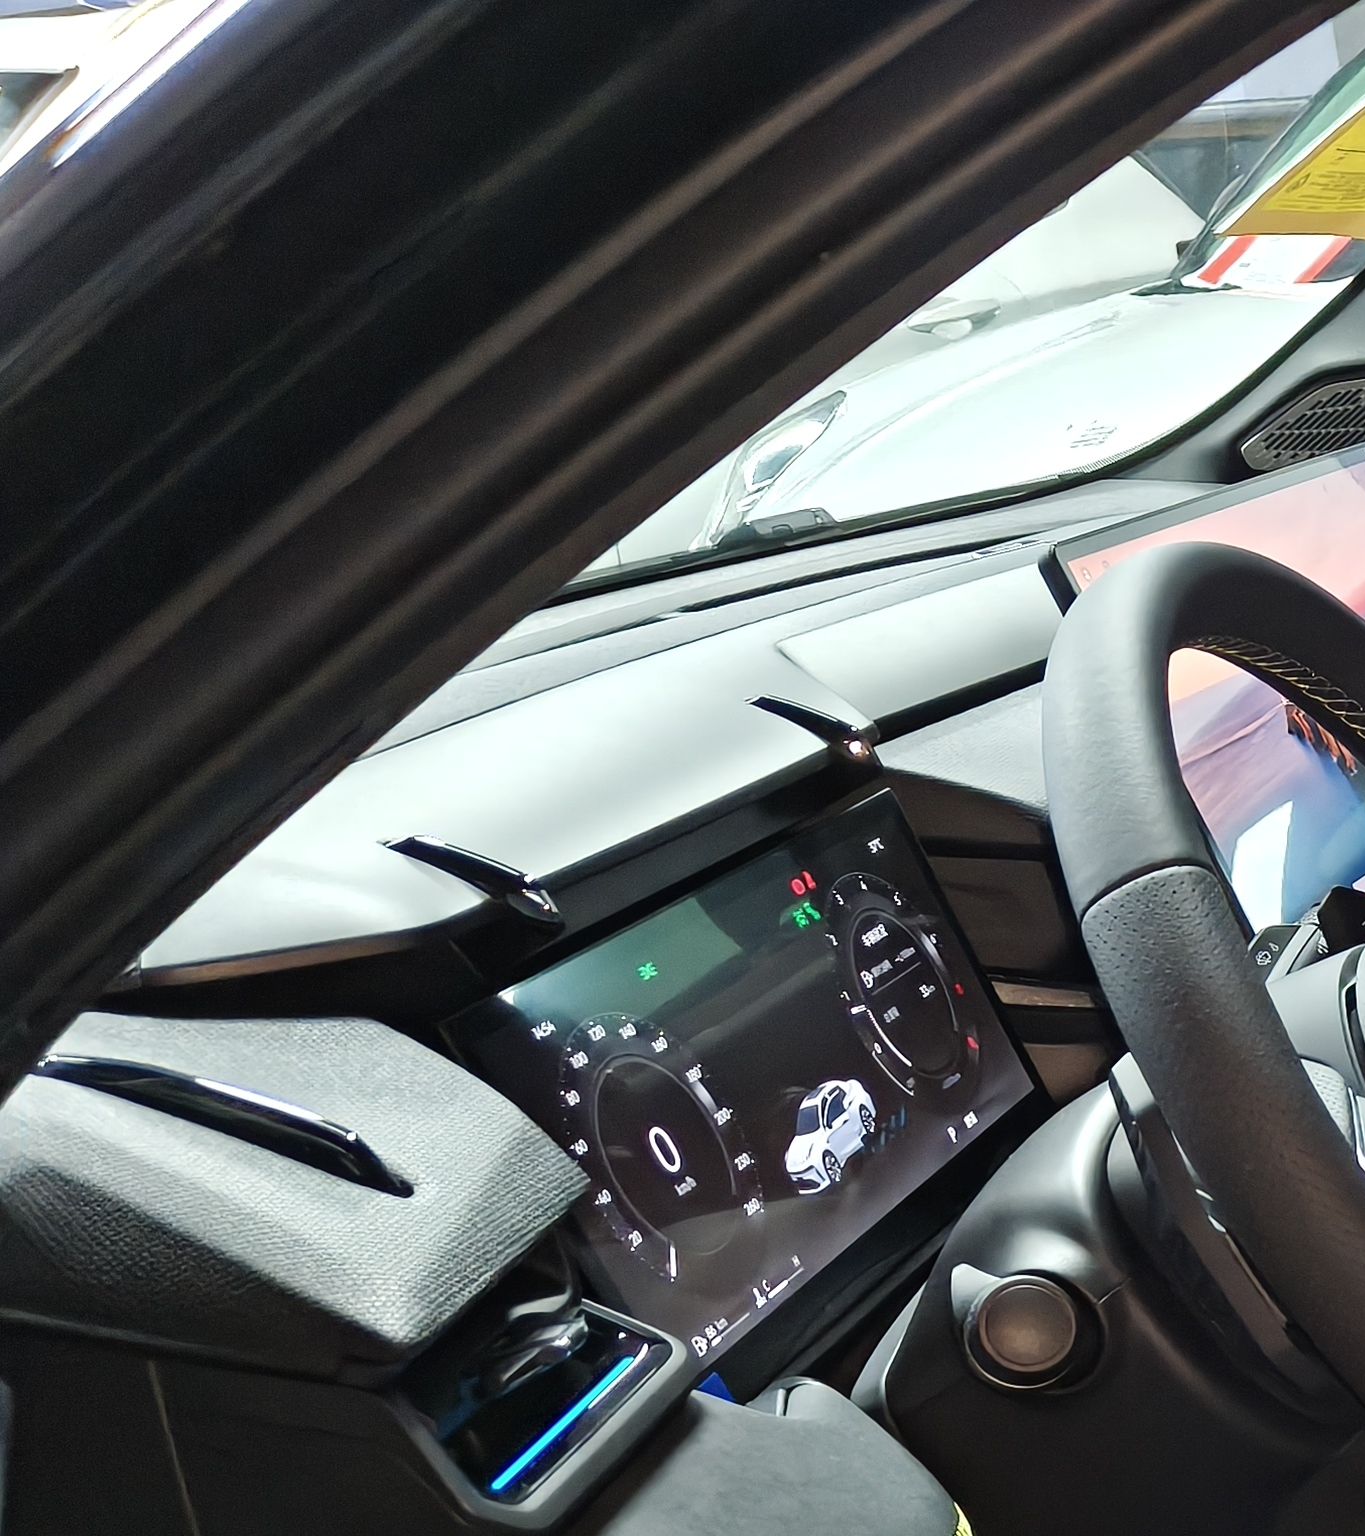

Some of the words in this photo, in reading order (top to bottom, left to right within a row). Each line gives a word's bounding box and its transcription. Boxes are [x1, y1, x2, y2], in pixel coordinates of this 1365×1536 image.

[587, 1024, 606, 1042] 120
[618, 1023, 637, 1040] 140
[568, 1050, 589, 1069] 100
[684, 1065, 702, 1083] 180
[565, 1089, 581, 1107] 80
[713, 1106, 731, 1126] 200
[648, 1126, 681, 1173] 0
[743, 1197, 760, 1216] 260
[628, 1229, 643, 1248] 20
